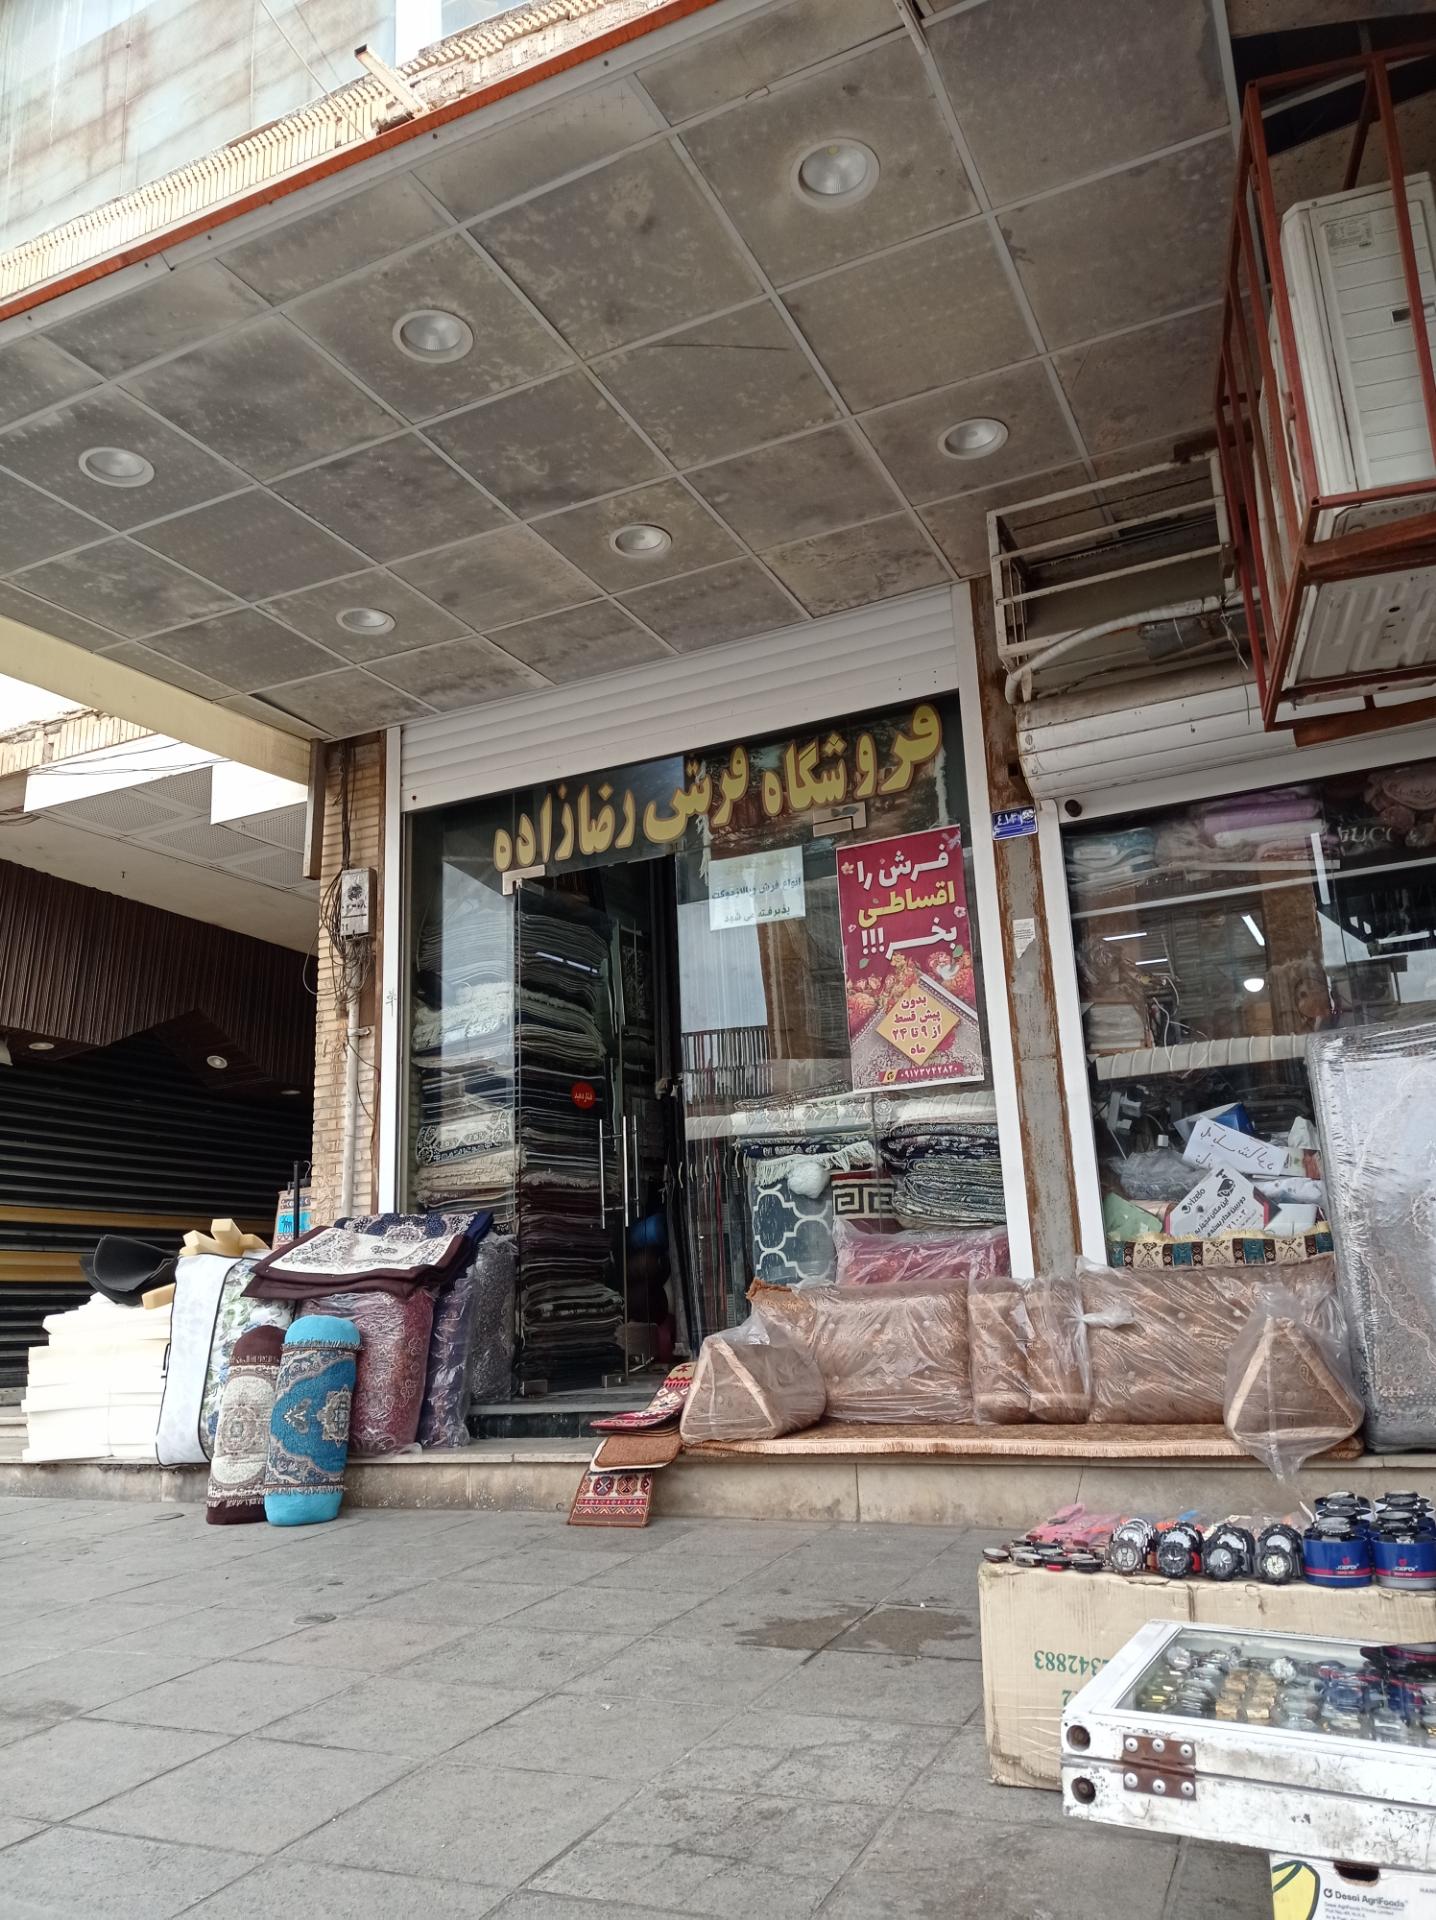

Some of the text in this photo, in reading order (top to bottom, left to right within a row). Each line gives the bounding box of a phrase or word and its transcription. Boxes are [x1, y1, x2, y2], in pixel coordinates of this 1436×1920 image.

[493, 703, 942, 872] فروشگاه فرش رضازاده
[857, 844, 949, 891] فرش را
[858, 880, 956, 928] اقساطی
[901, 996, 927, 1009] بدون
[894, 1009, 941, 1023] پیش قسط
[910, 1027, 919, 1038] تا
[921, 1025, 928, 1037] ۹
[931, 1024, 941, 1039] از
[910, 1043, 926, 1054] ماه
[1033, 1650, 1111, 1676] 342883
[1335, 1891, 1405, 1908] Desai AgriFoods
